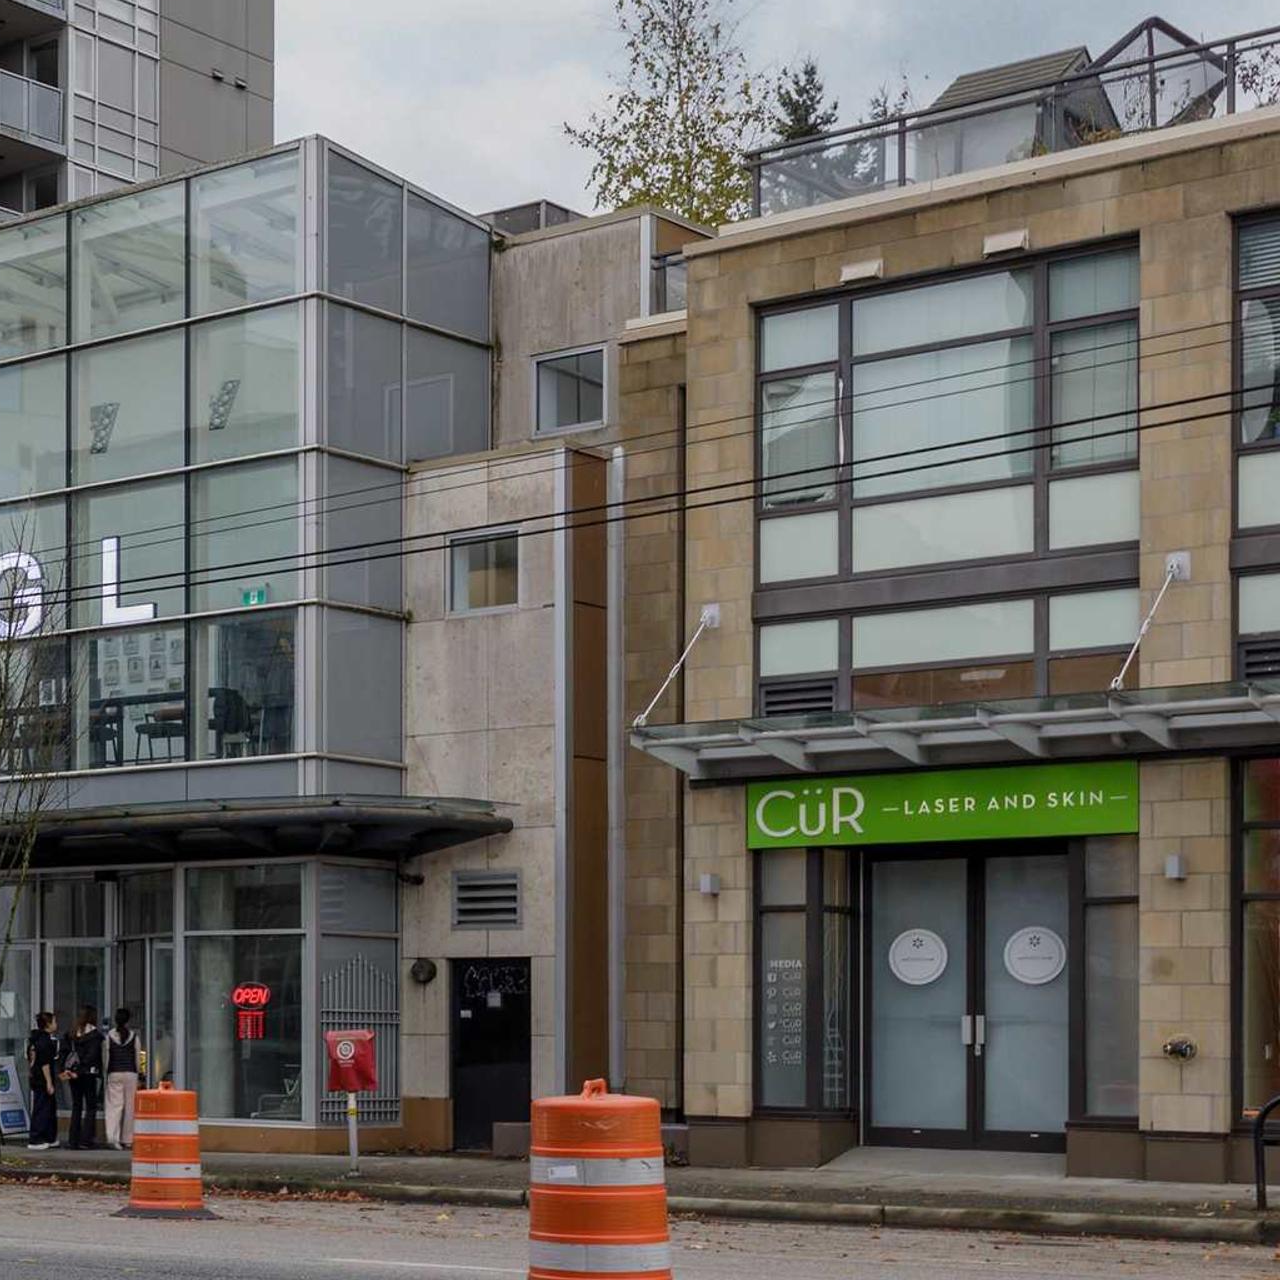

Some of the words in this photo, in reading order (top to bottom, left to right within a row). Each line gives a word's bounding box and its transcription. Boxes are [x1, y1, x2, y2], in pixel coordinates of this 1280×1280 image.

[755, 787, 865, 837] CüR
[904, 797, 976, 816] LASER
[987, 793, 1036, 811] AND
[1047, 790, 1104, 808] SKIN
[233, 988, 268, 1004] OPEN
